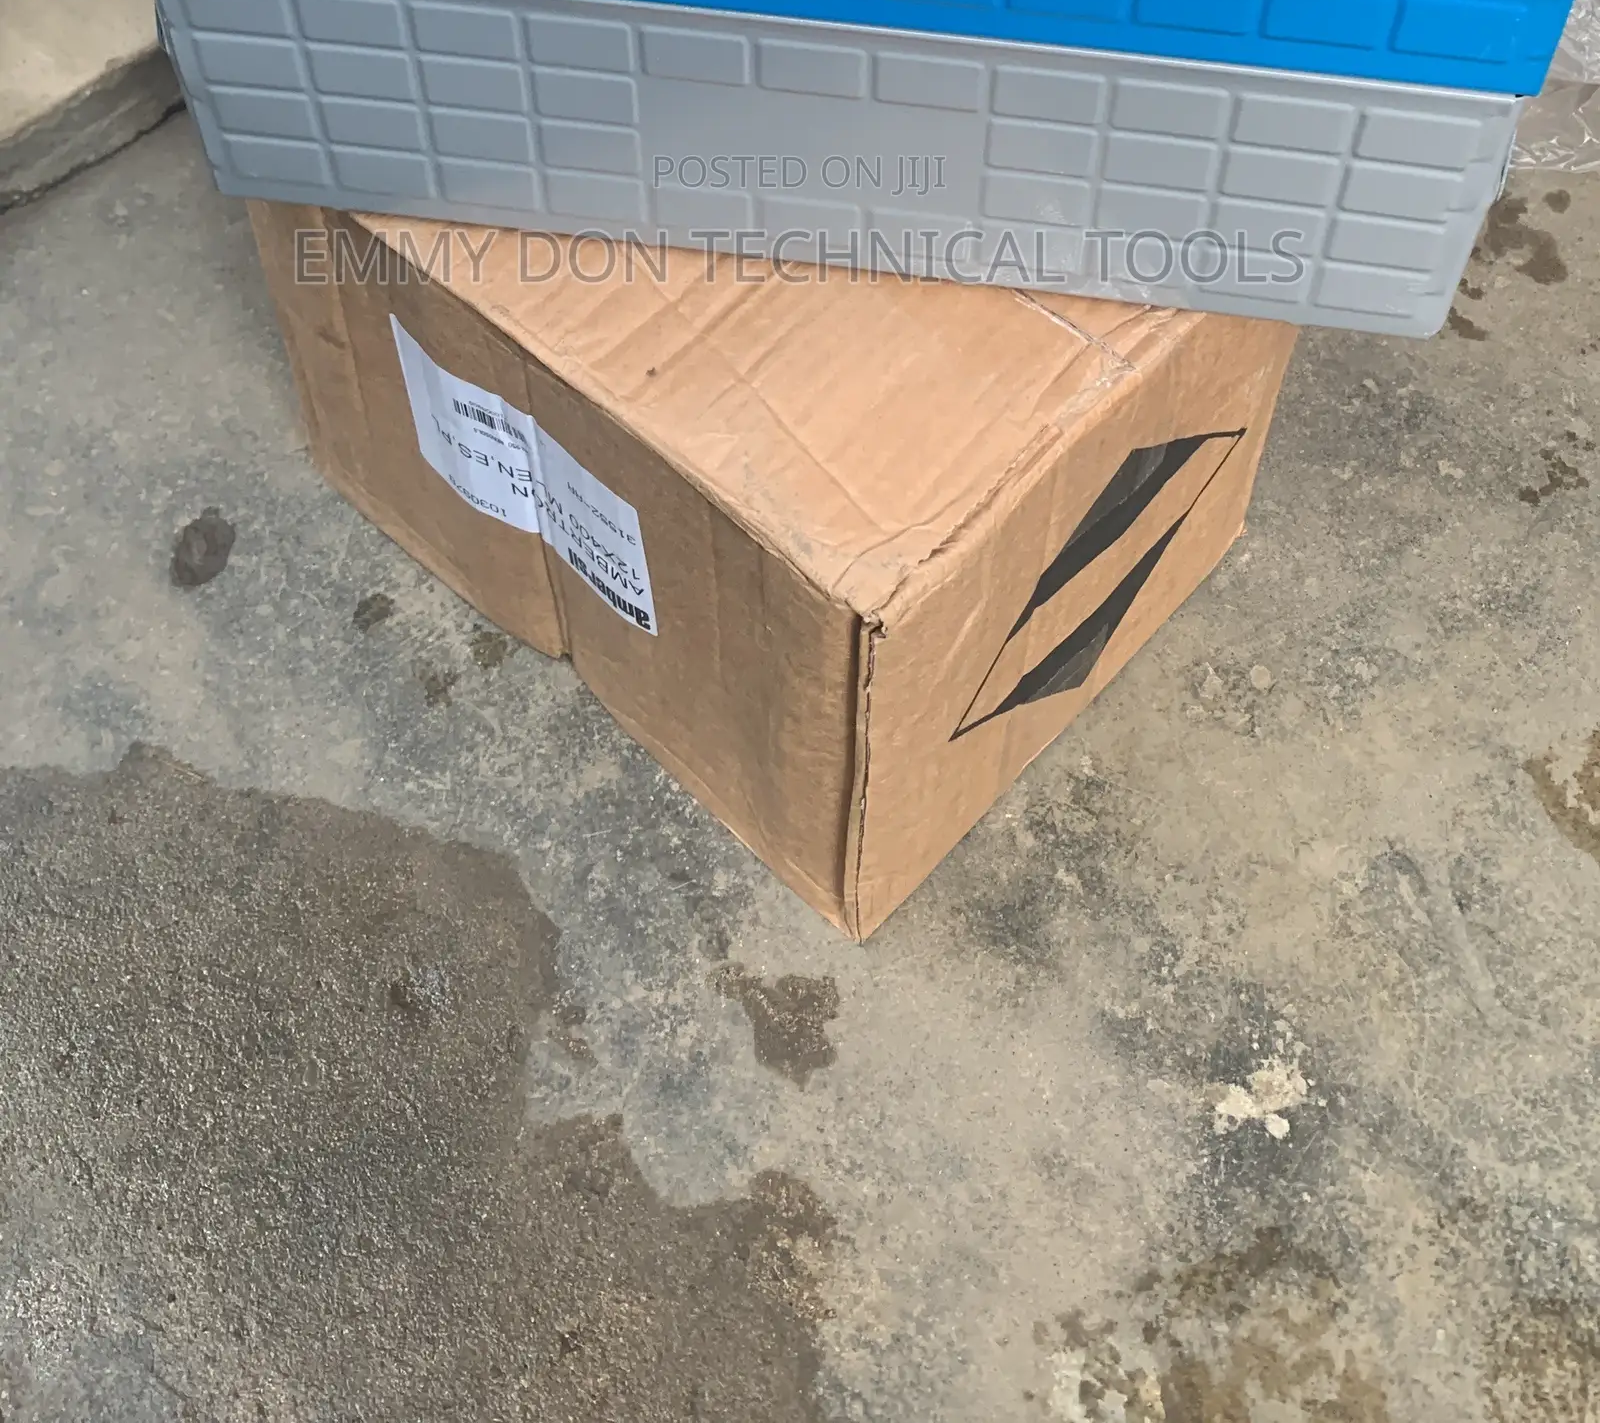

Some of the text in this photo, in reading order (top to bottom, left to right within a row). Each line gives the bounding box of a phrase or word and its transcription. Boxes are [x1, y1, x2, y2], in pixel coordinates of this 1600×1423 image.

[510, 481, 645, 596] AMBERTRON
[568, 512, 641, 581] 12X400
[567, 546, 652, 631] ambersil
